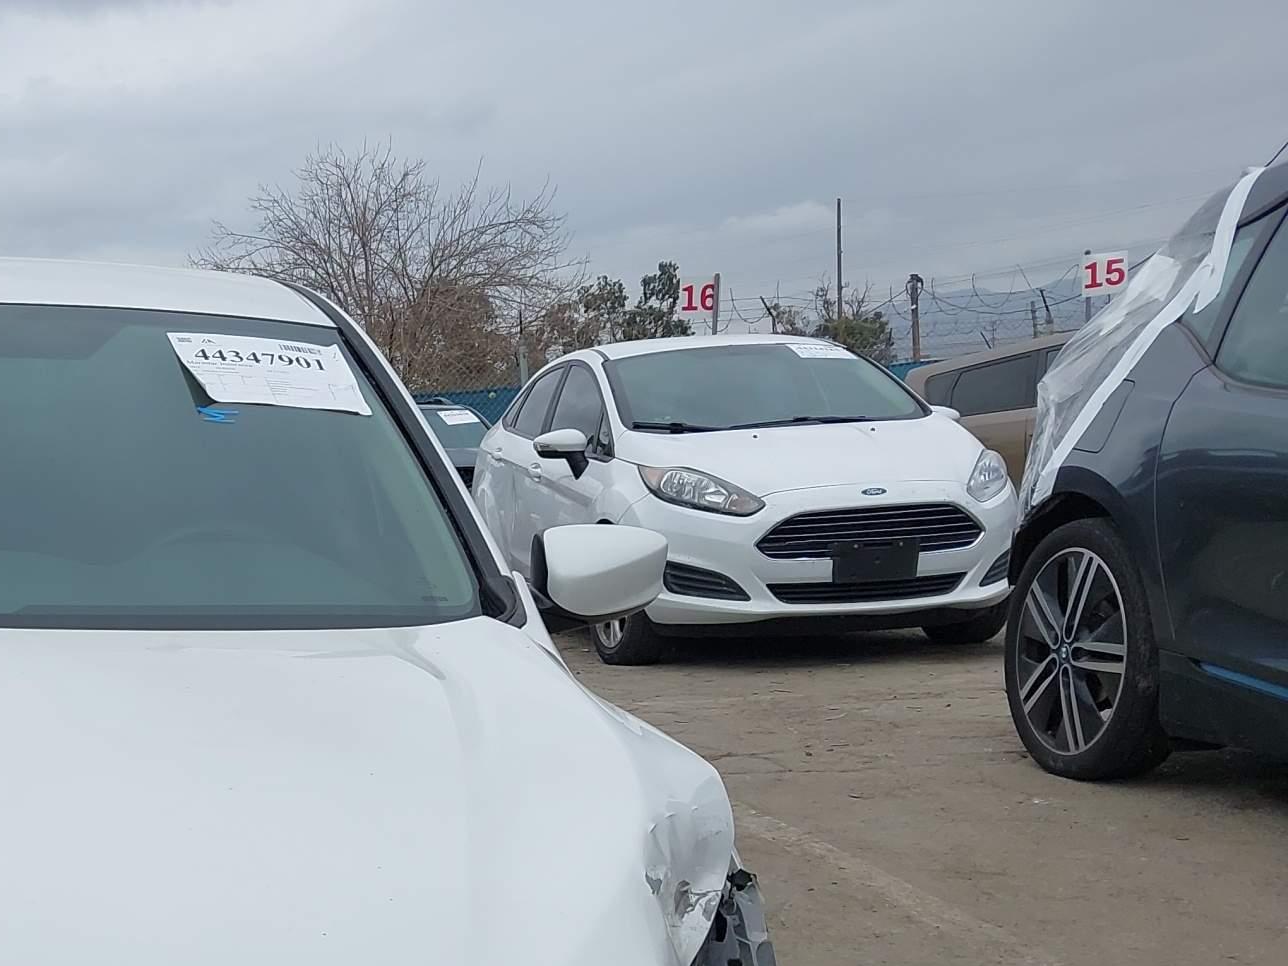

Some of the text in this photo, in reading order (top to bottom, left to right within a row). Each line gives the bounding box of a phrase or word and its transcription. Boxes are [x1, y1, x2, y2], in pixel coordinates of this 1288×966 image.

[1085, 258, 1125, 289] 15
[682, 284, 715, 311] 16
[194, 348, 325, 371] 44347901
